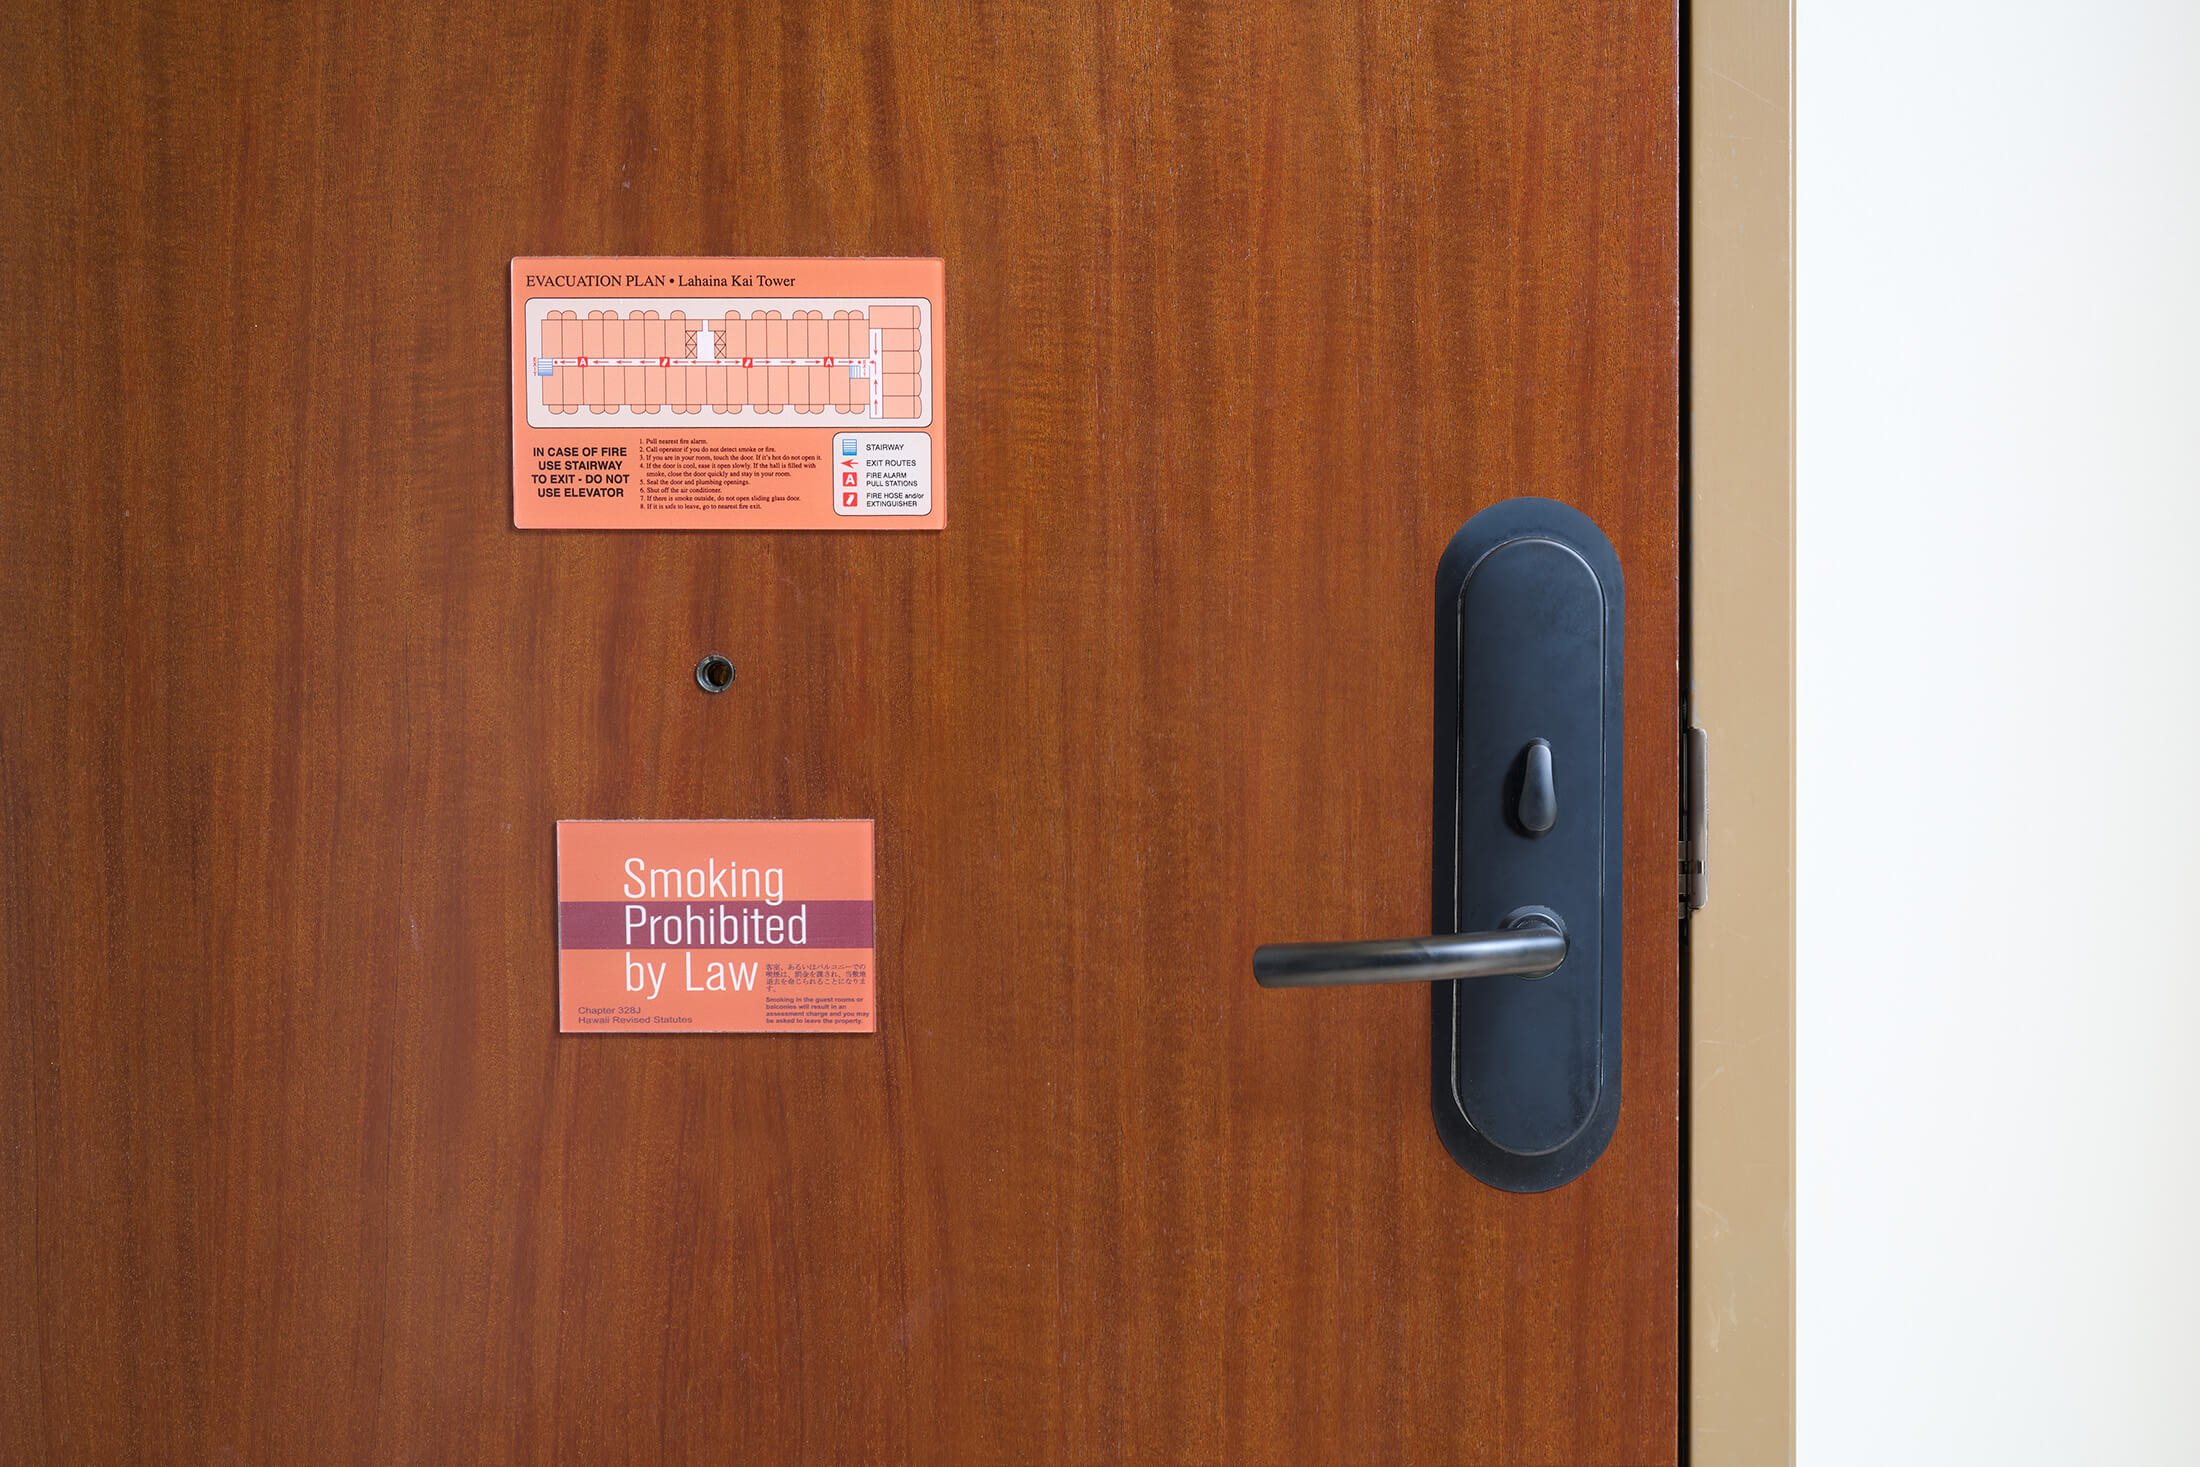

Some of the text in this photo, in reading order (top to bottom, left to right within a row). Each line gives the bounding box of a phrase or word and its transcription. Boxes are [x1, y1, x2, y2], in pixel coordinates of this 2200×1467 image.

[526, 273, 795, 287] EVACUATION PLAN Lahaina Kai Tower
[579, 358, 586, 366] A
[825, 358, 832, 366] A
[534, 447, 627, 457] IN CASE OF FIRE
[539, 461, 622, 470] USE STAIRWAY
[531, 474, 630, 484] TO EXIT DO NOT
[845, 474, 855, 484] A
[538, 488, 623, 497] USE ELEVATOR
[624, 858, 782, 905] Smoking
[626, 904, 806, 944] Prohibited
[626, 952, 758, 999] by Law
[578, 1007, 641, 1016] Chapter 328J
[579, 1016, 610, 1024] Hawaii
